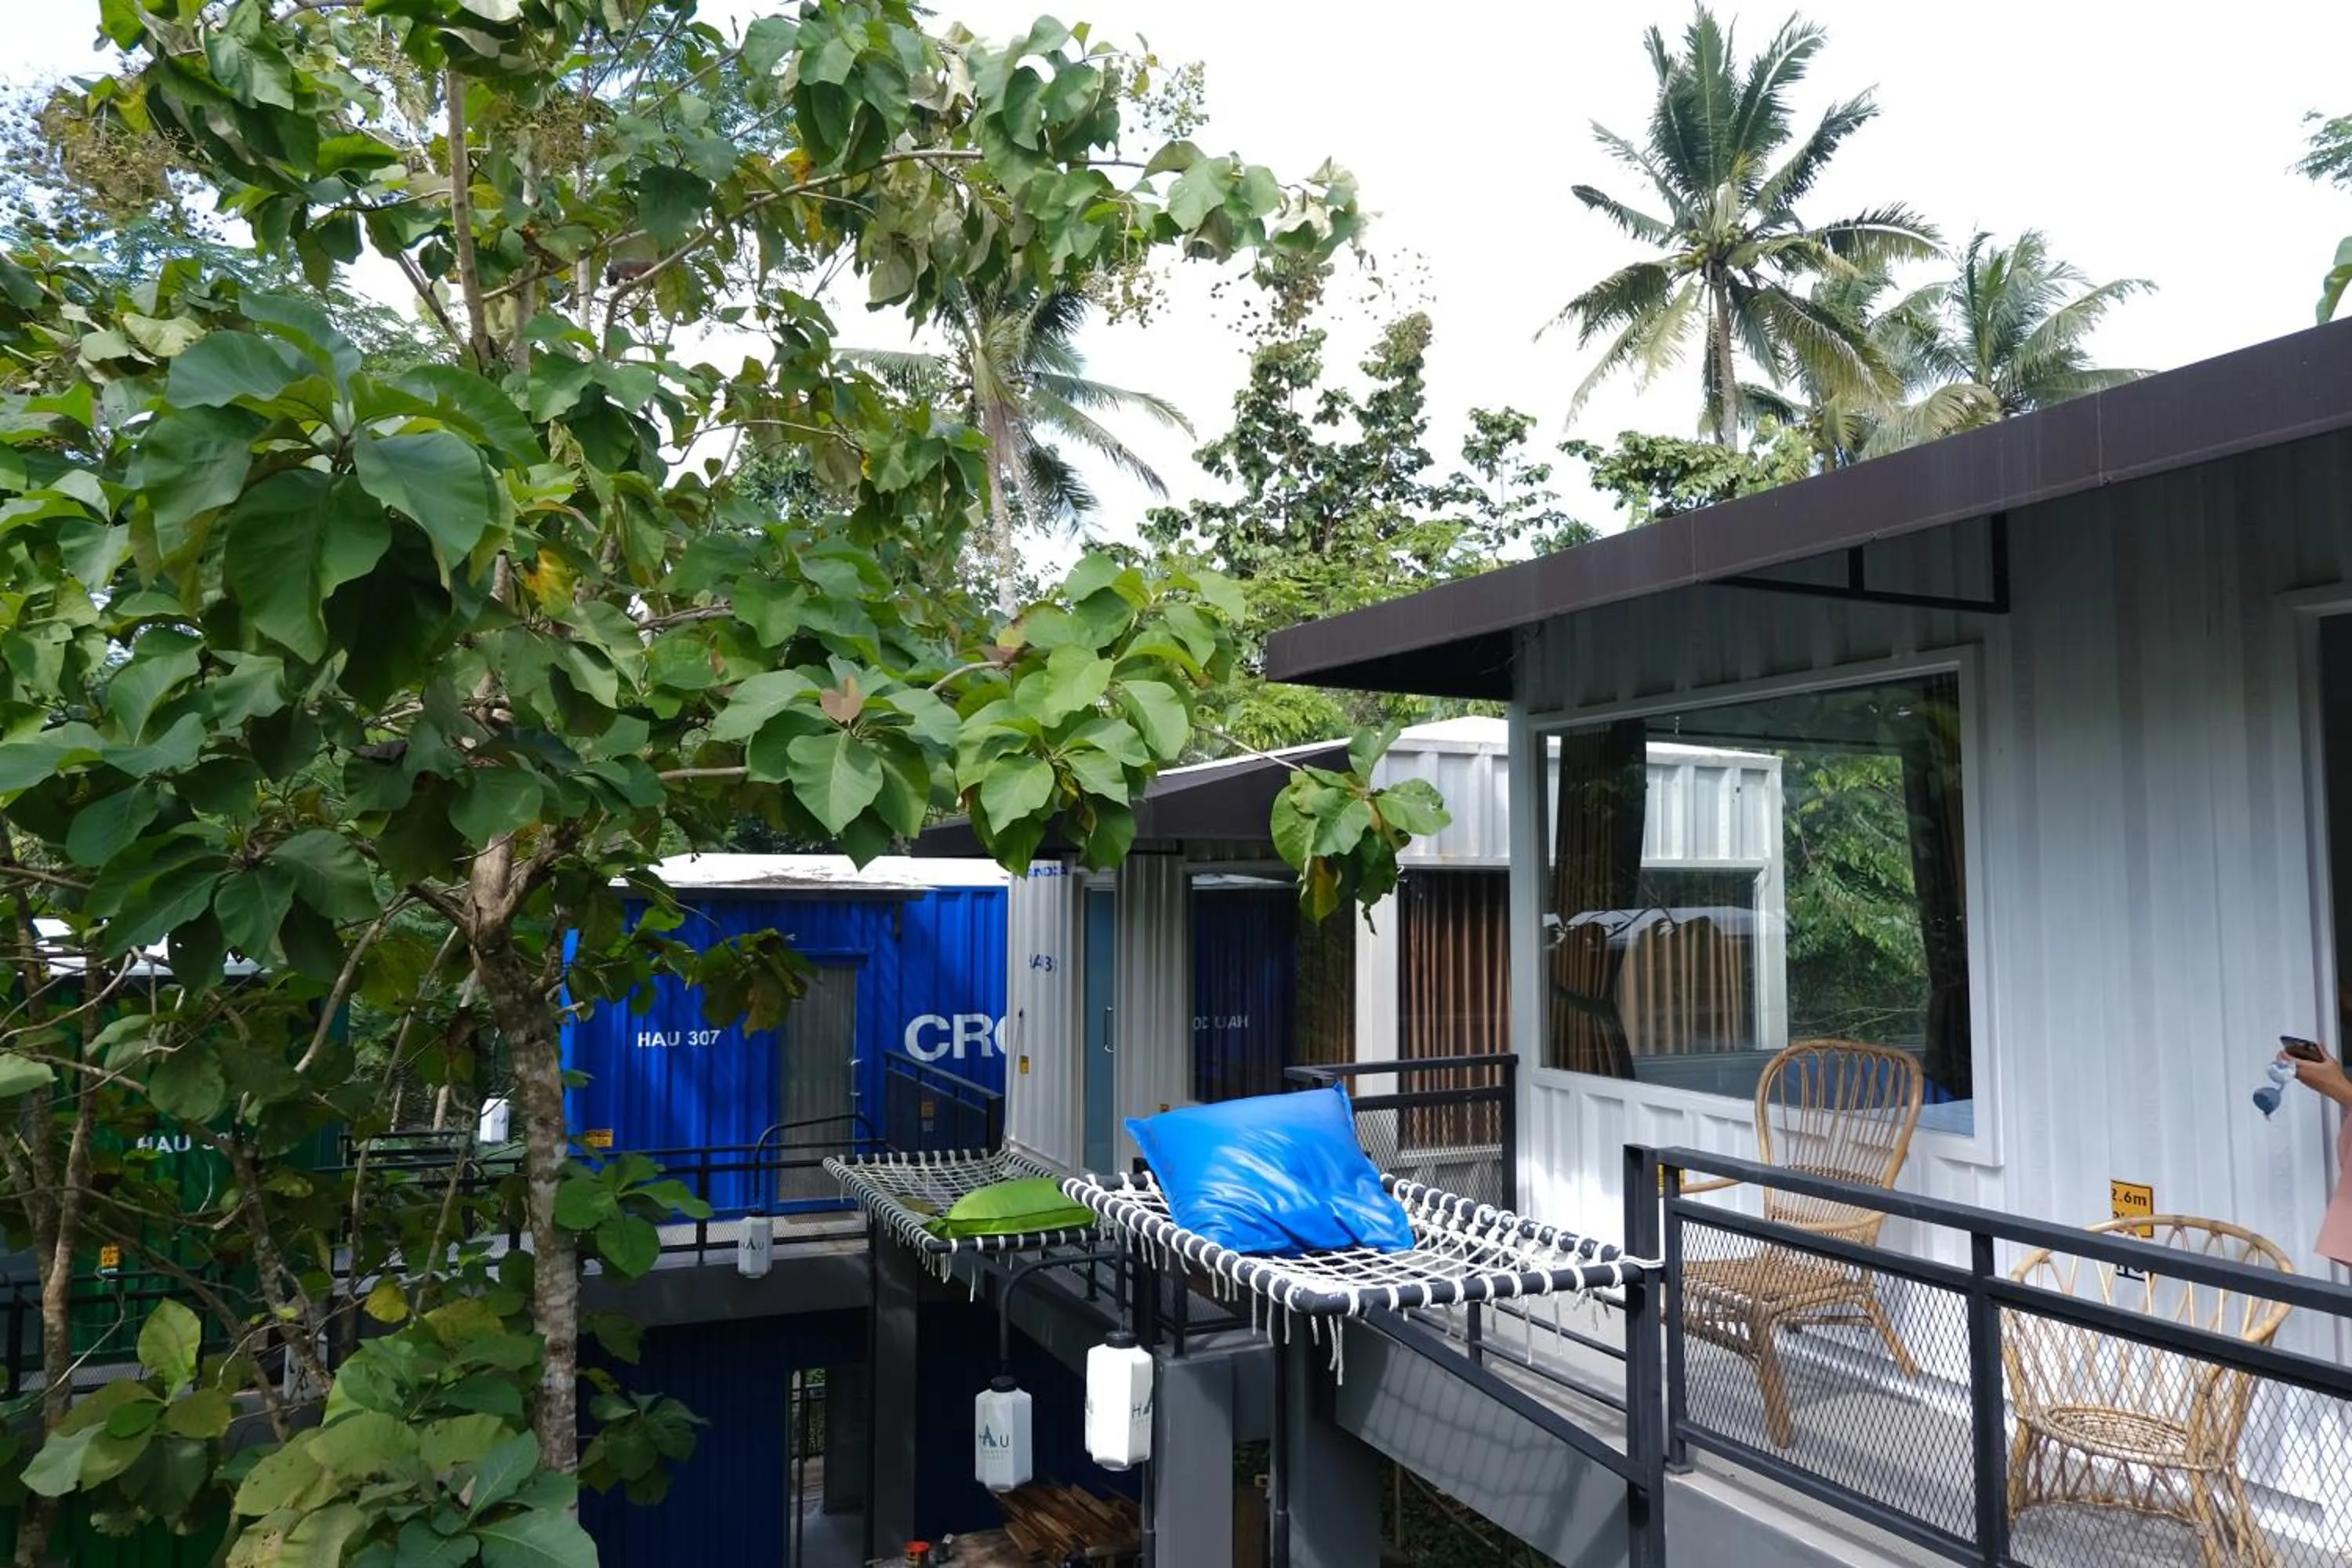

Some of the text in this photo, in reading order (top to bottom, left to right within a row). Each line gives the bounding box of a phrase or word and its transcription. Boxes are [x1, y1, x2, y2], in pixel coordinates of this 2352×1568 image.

[637, 1029, 721, 1047] HAU 307
[904, 1014, 1007, 1062] CR
[136, 1134, 192, 1153] HAU
[739, 1236, 764, 1250] HAU
